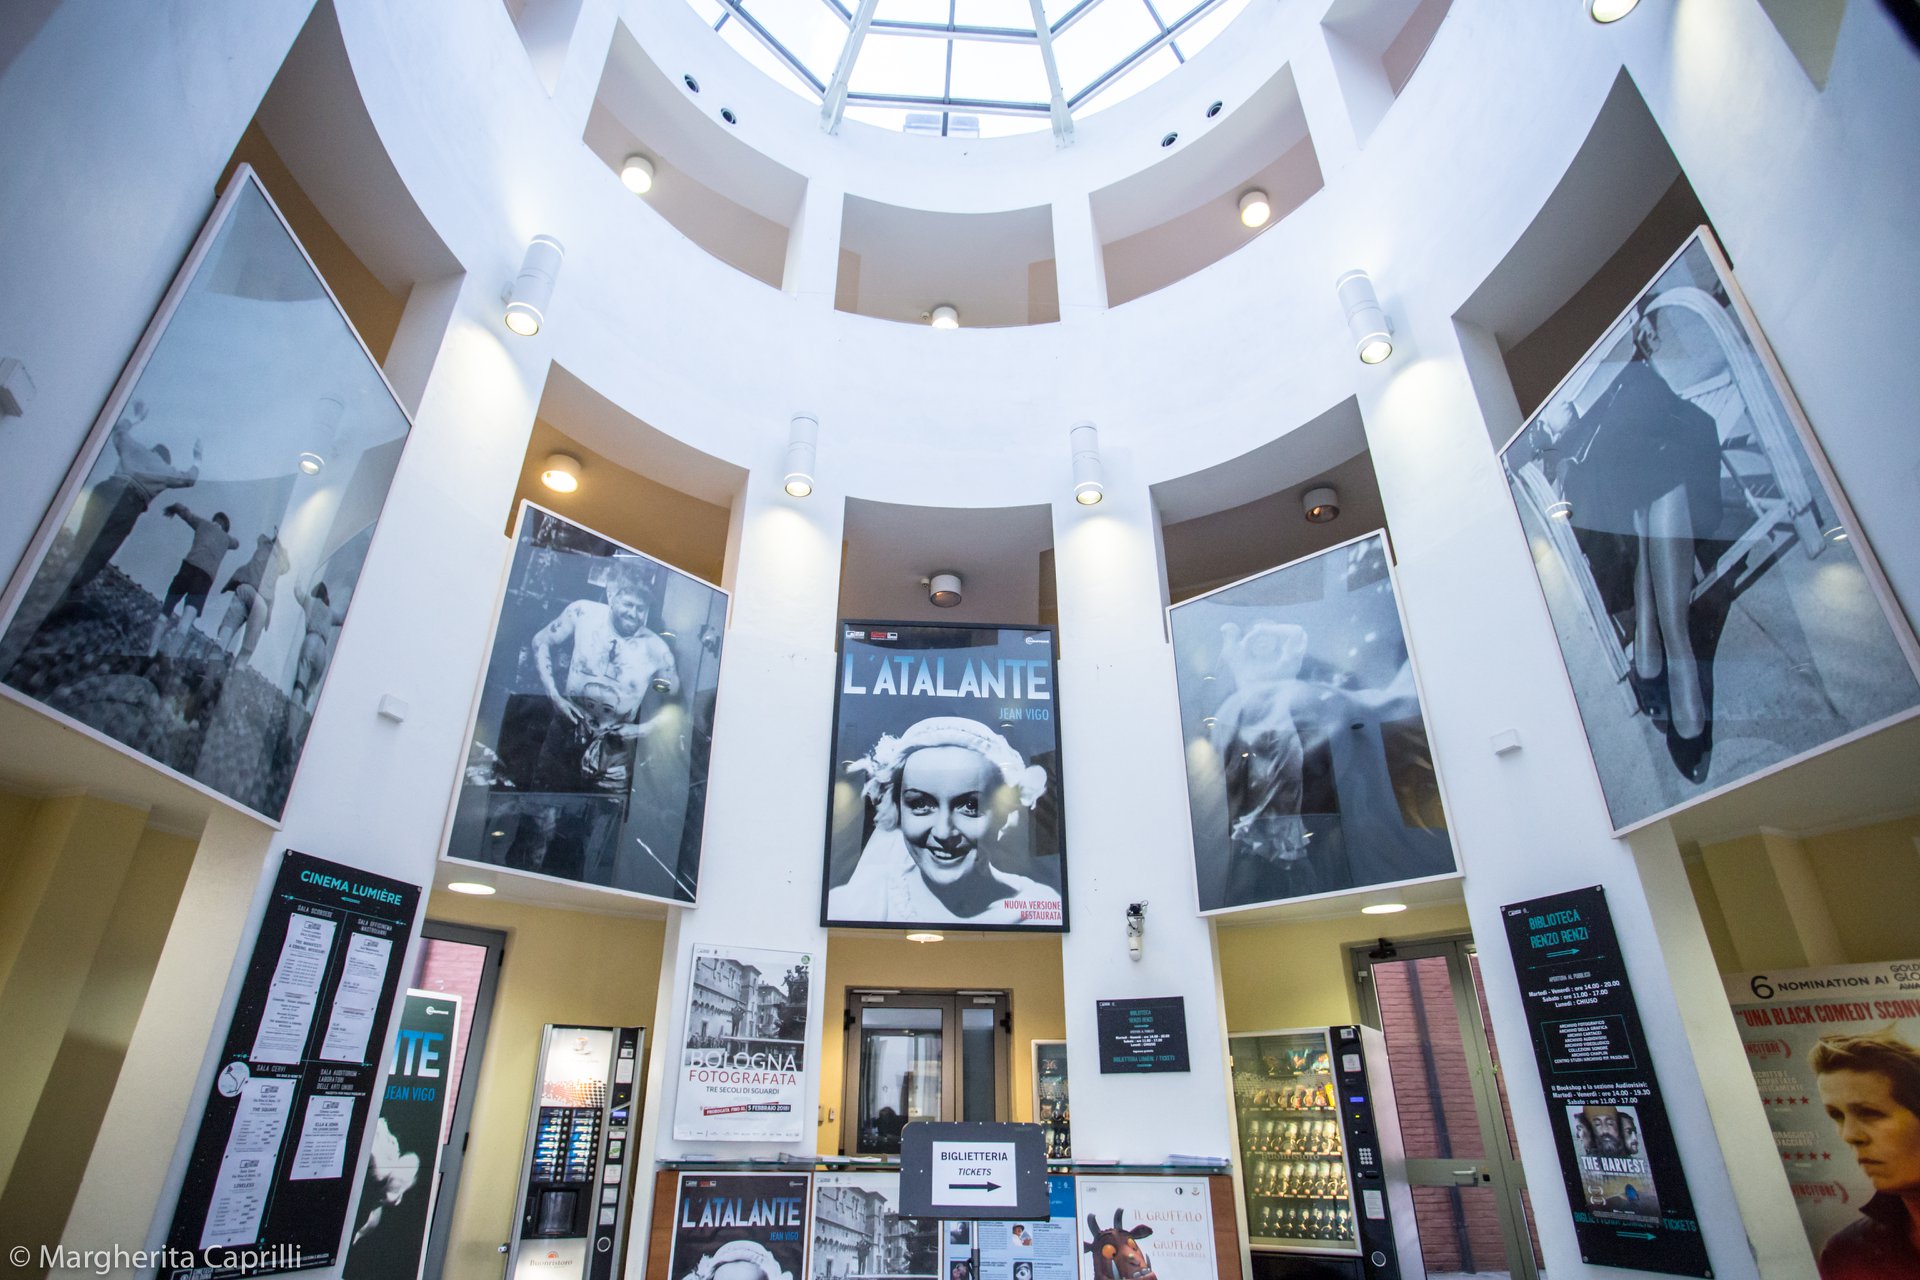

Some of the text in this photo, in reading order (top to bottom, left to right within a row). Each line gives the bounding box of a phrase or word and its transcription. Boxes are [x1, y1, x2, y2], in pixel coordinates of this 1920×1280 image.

[843, 652, 1050, 700] L'ATALANTE
[999, 708, 1049, 720] JEAN VIGO
[300, 870, 402, 906] CINEMA LUMIÈRE
[1004, 900, 1061, 910] NUOVA VERSIONE
[1020, 911, 1062, 920] RESTAURATA
[1528, 910, 1580, 930] BIBLIOTECA
[1530, 926, 1589, 948] RENZO RENZI
[1750, 975, 1889, 1000] 6 NOMINATION AI
[1770, 1004, 1816, 1025] BLACK
[1814, 1002, 1874, 1022] COMEDY
[690, 1048, 797, 1072] BOLOGNA
[689, 1070, 796, 1086] FOTOGRAFATA
[385, 1085, 435, 1101] JEAN VIGO
[941, 1152, 1008, 1161] BIGLIETTERIA
[1581, 1156, 1646, 1174] THE HARVEST
[682, 1196, 801, 1228] L'ATALANTE
[1134, 1209, 1143, 1220] IL
[1663, 1218, 1697, 1232] TICKETS
[770, 1232, 798, 1241] JEAN VIGO
